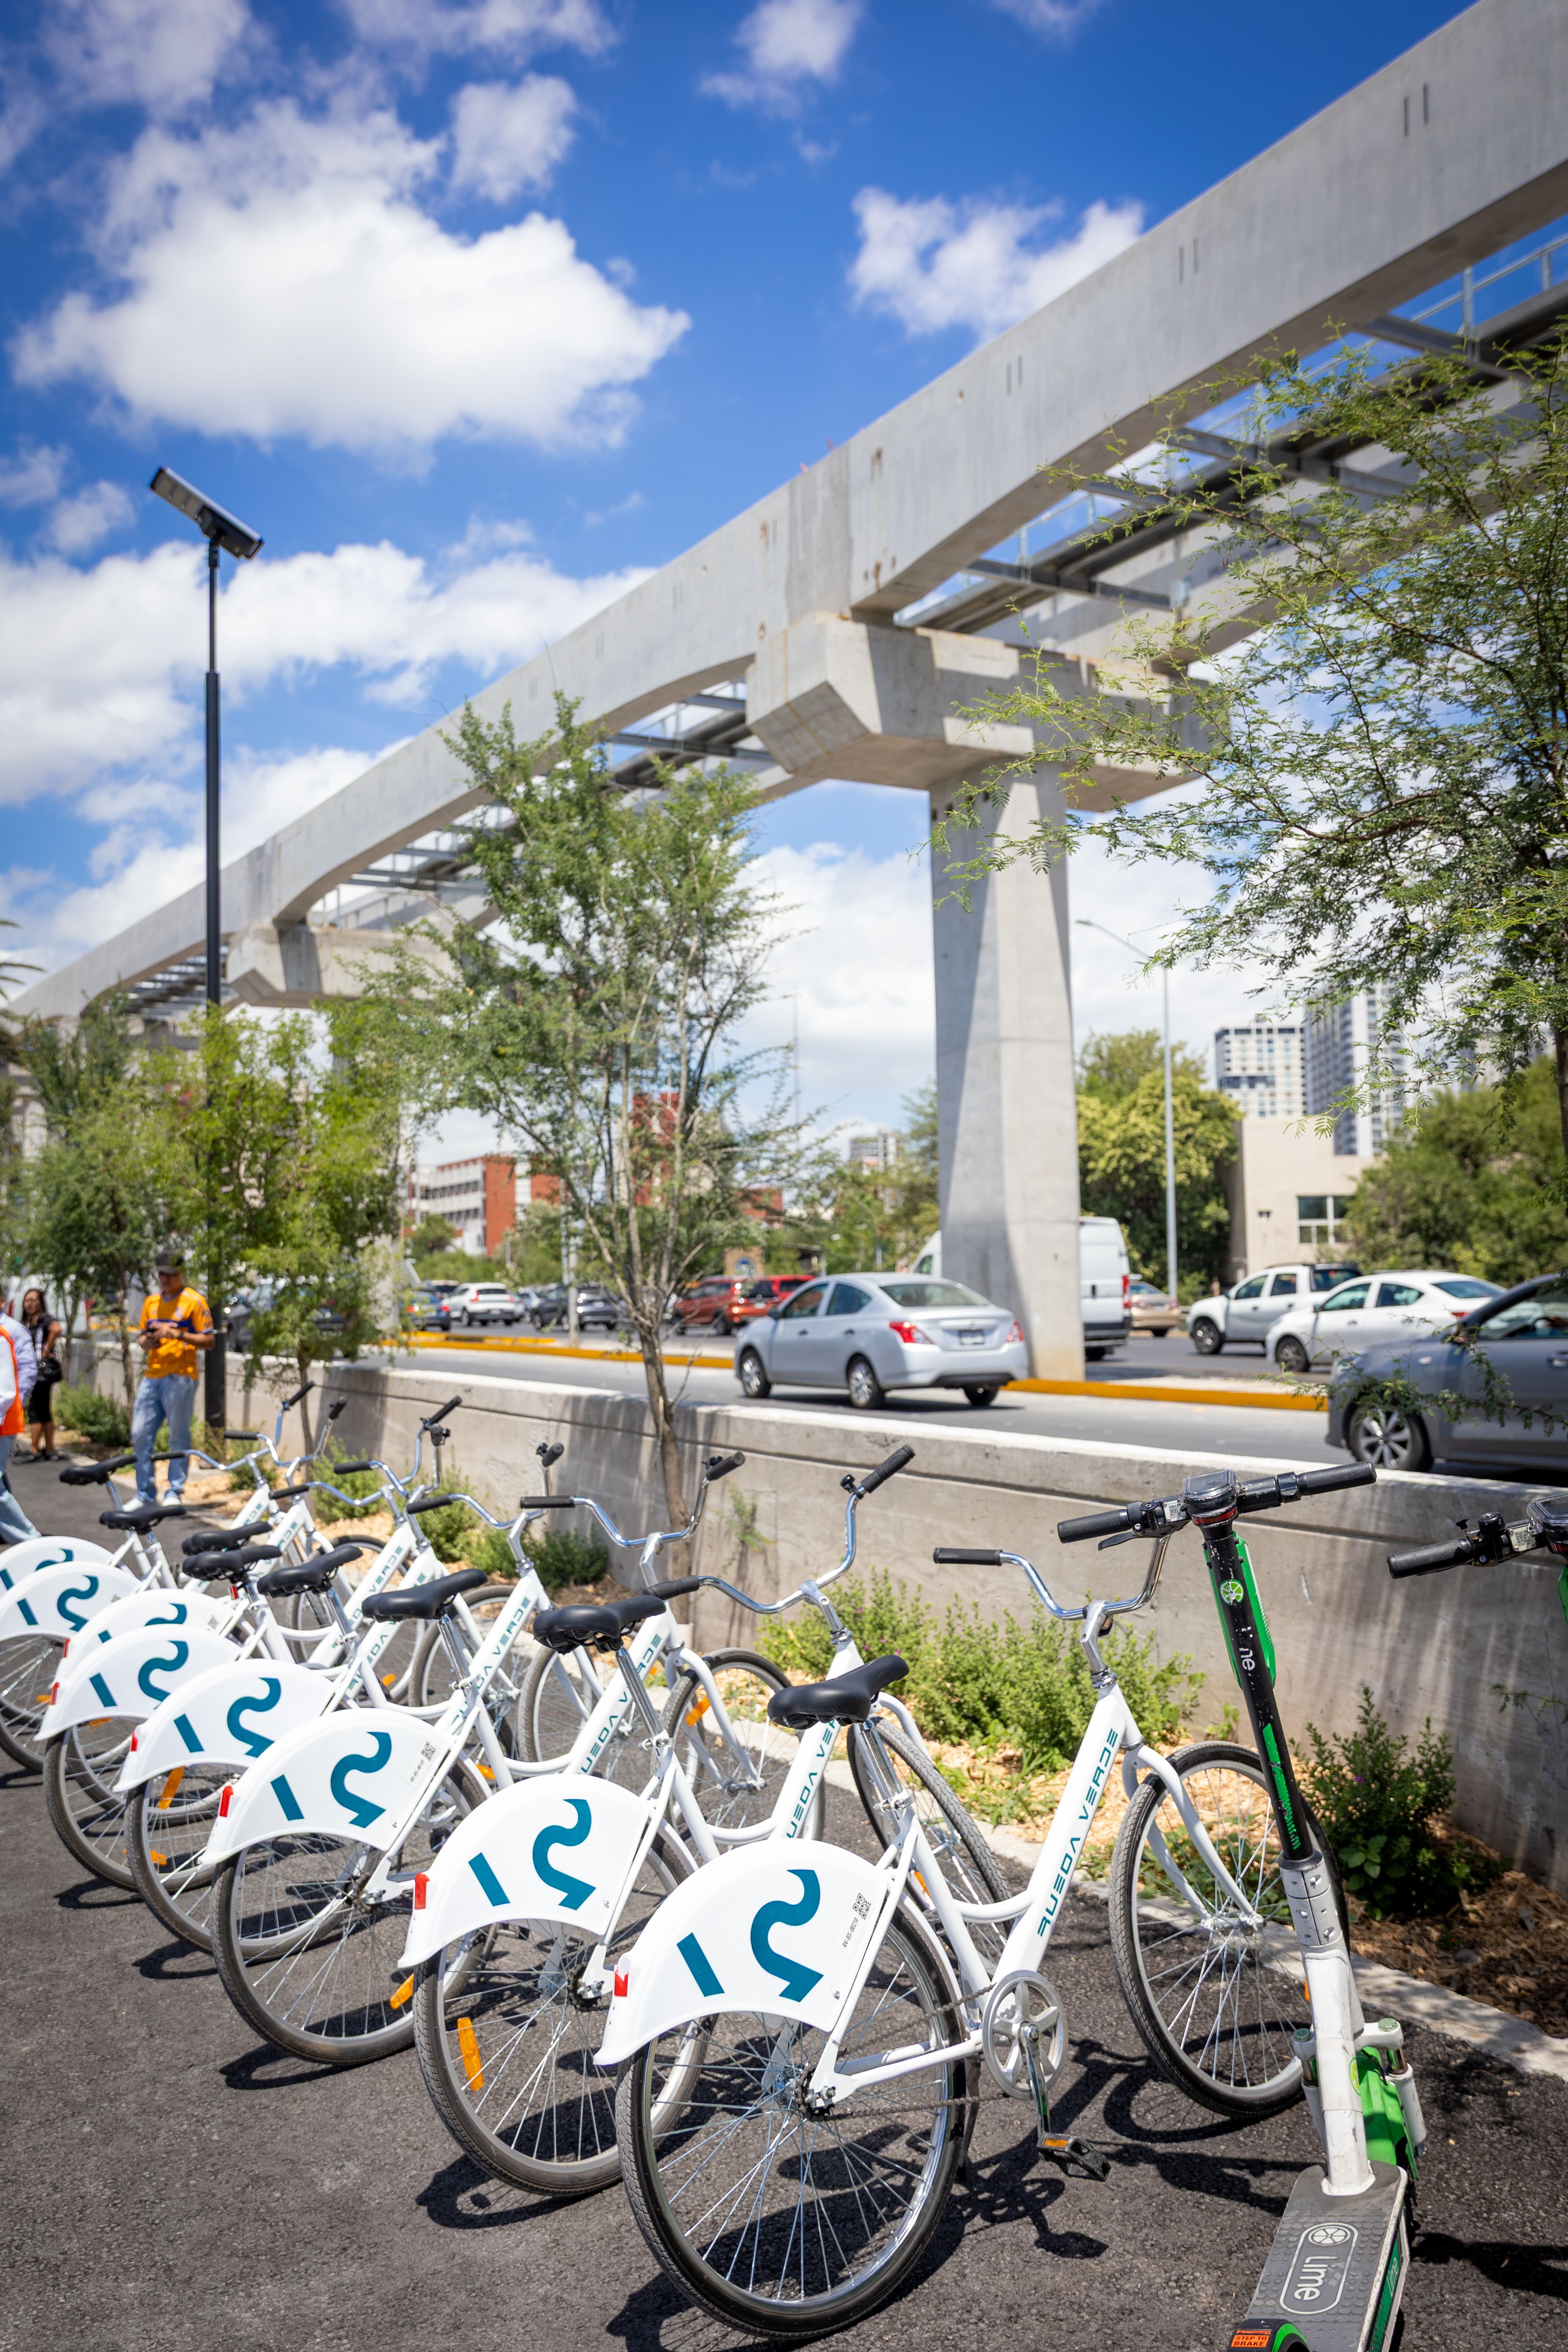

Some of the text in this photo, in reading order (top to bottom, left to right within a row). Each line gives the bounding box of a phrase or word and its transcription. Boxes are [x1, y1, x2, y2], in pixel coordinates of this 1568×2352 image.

[370, 1546, 402, 1592] VERDE
[493, 1596, 531, 1655] VERDE
[578, 1634, 662, 1774] UEDA VRDE
[786, 1772, 818, 1839] UEDA
[1037, 1728, 1118, 1937] RUEDA VERDE
[1293, 2256, 1339, 2300] Lime
